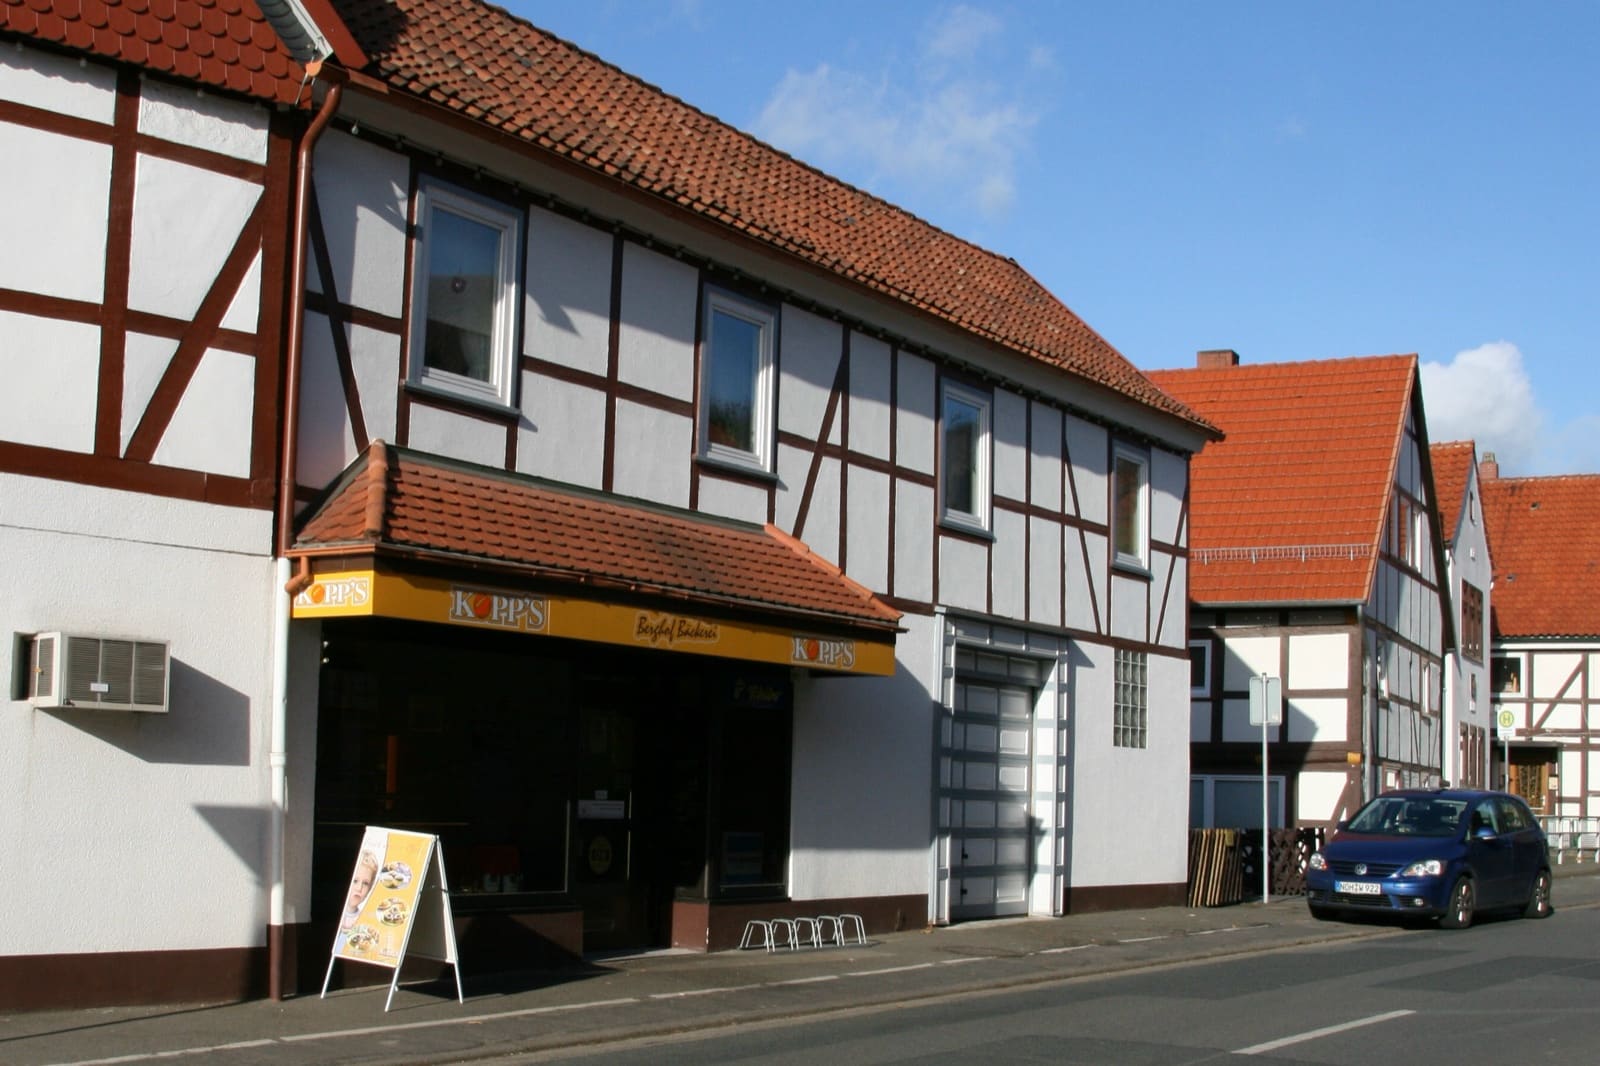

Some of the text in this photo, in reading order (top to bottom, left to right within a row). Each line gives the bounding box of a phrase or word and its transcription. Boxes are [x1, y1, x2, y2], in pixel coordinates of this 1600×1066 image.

[455, 590, 545, 626] KOPP'S
[636, 615, 677, 644] Berghof
[794, 637, 854, 667] KOPP'S
